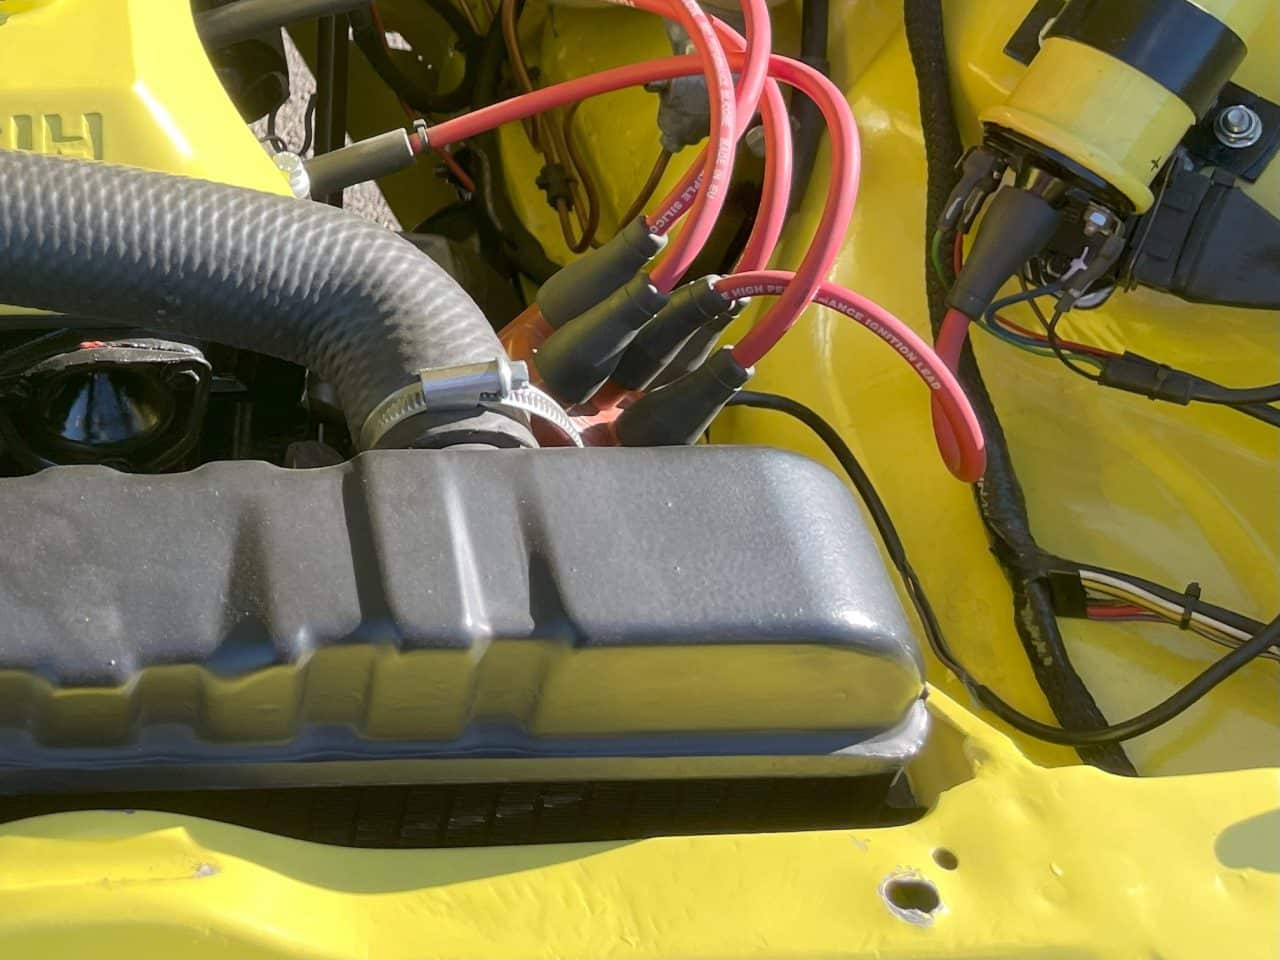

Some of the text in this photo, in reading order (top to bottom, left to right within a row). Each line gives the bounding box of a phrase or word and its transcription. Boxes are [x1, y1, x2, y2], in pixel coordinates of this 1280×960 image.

[649, 201, 684, 235] SILICO
[732, 284, 765, 298] HIGH
[865, 318, 918, 362] IGNITION
[915, 360, 942, 392] LEAD
